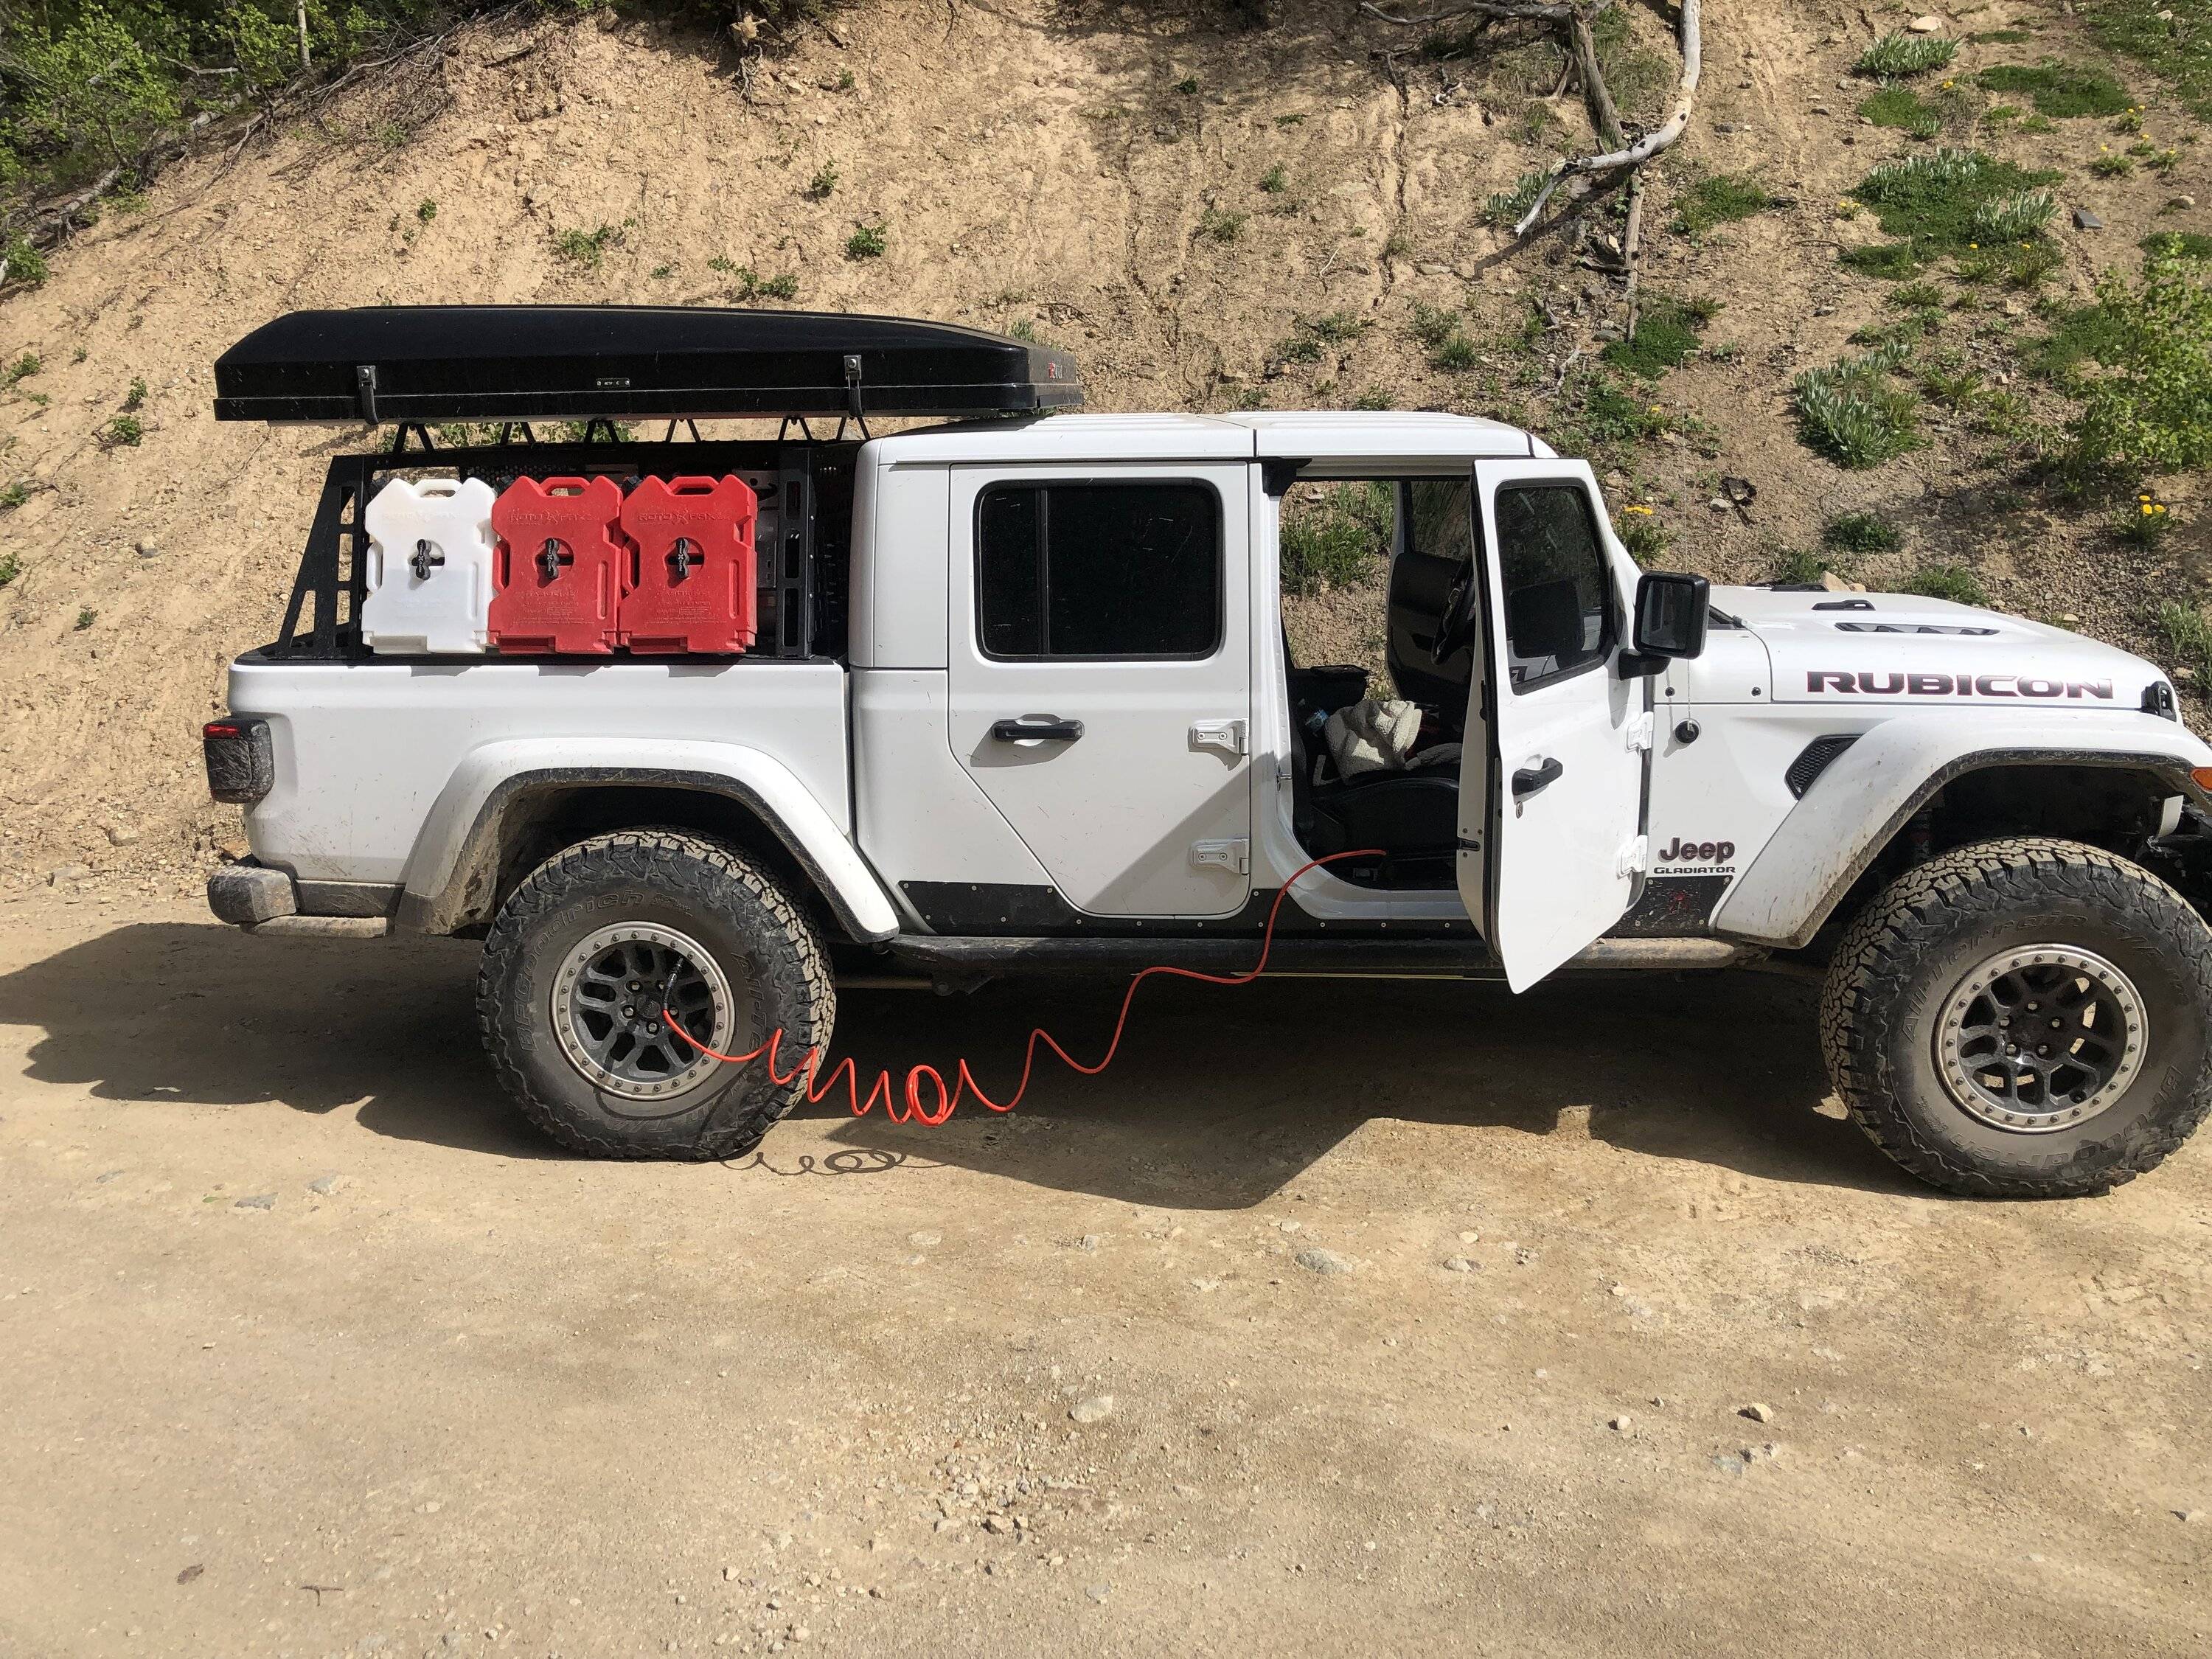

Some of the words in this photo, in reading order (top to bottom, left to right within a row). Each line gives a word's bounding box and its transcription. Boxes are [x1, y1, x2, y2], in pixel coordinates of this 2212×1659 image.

[1807, 671, 2114, 699] RUBICON
[1658, 837, 1736, 865] Jeep
[1654, 866, 1736, 874] GLADIATOR
[513, 889, 644, 1051] BFGoodrich
